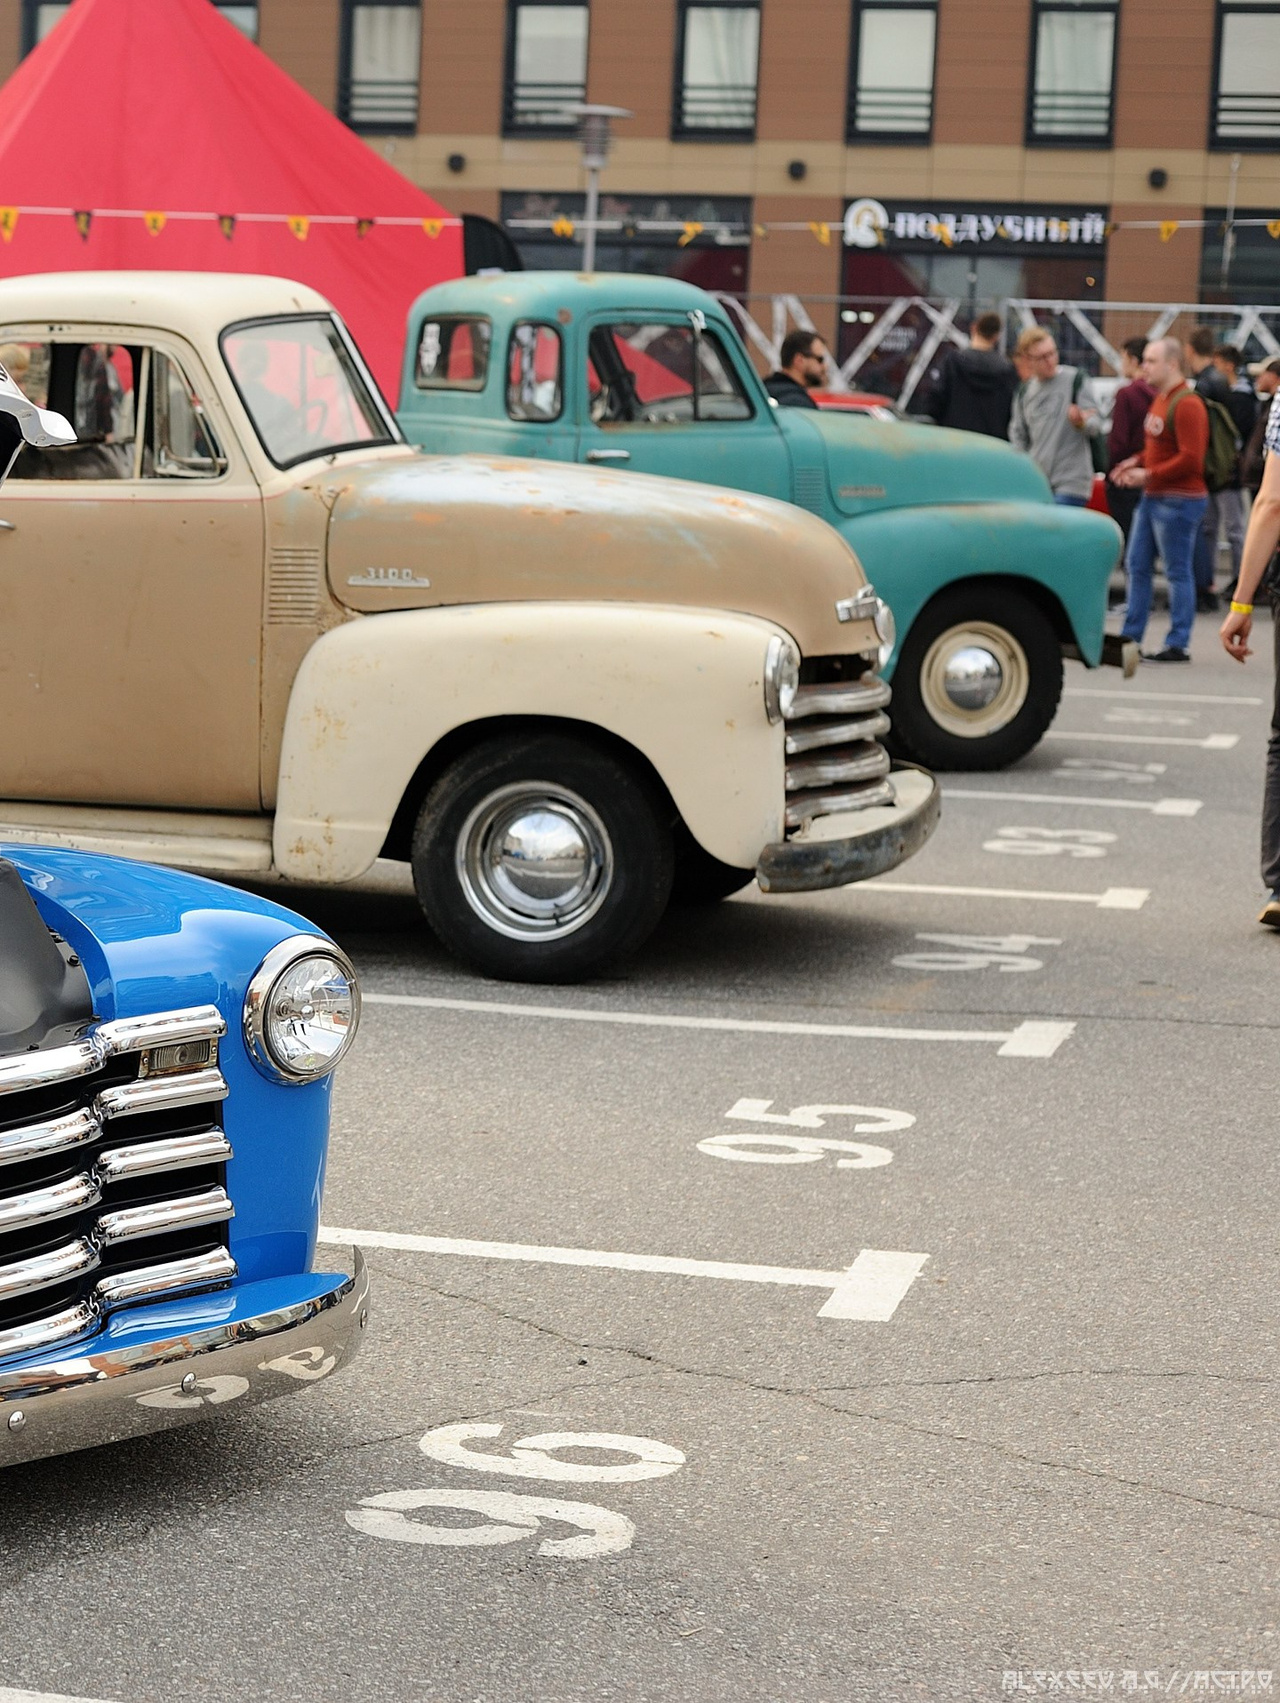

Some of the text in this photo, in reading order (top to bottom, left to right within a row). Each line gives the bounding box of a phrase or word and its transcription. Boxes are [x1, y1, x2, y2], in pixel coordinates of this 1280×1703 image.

[366, 567, 412, 580] 3100
[982, 826, 1119, 858] 93
[891, 932, 1063, 972] 94
[696, 1097, 916, 1169] 95
[344, 1423, 687, 1560] 96
